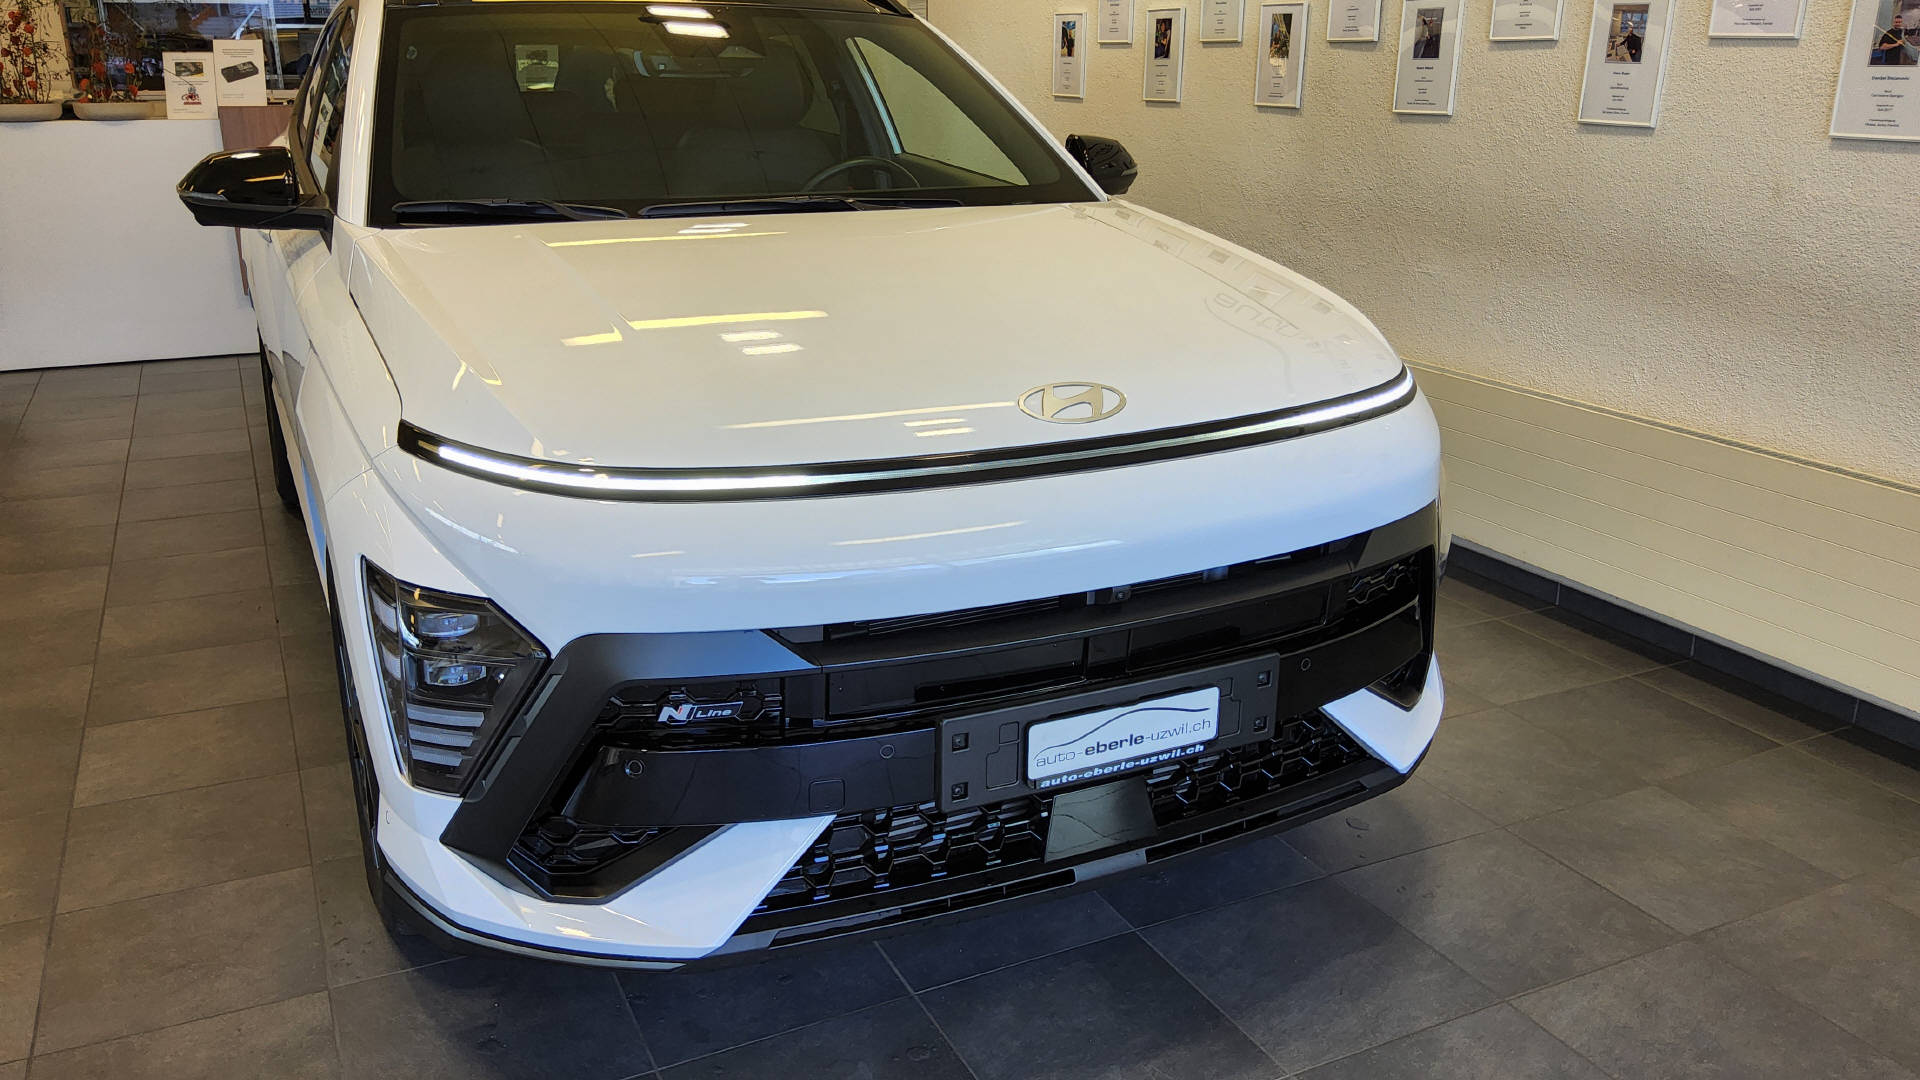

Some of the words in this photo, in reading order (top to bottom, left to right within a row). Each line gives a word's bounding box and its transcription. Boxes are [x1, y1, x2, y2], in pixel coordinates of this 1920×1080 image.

[657, 703, 694, 722] N
[696, 708, 732, 718] Line
[1036, 718, 1211, 768] auto-eberle-uzwil.ch
[1040, 743, 1205, 788] auto-eberle-uzwil.ch
